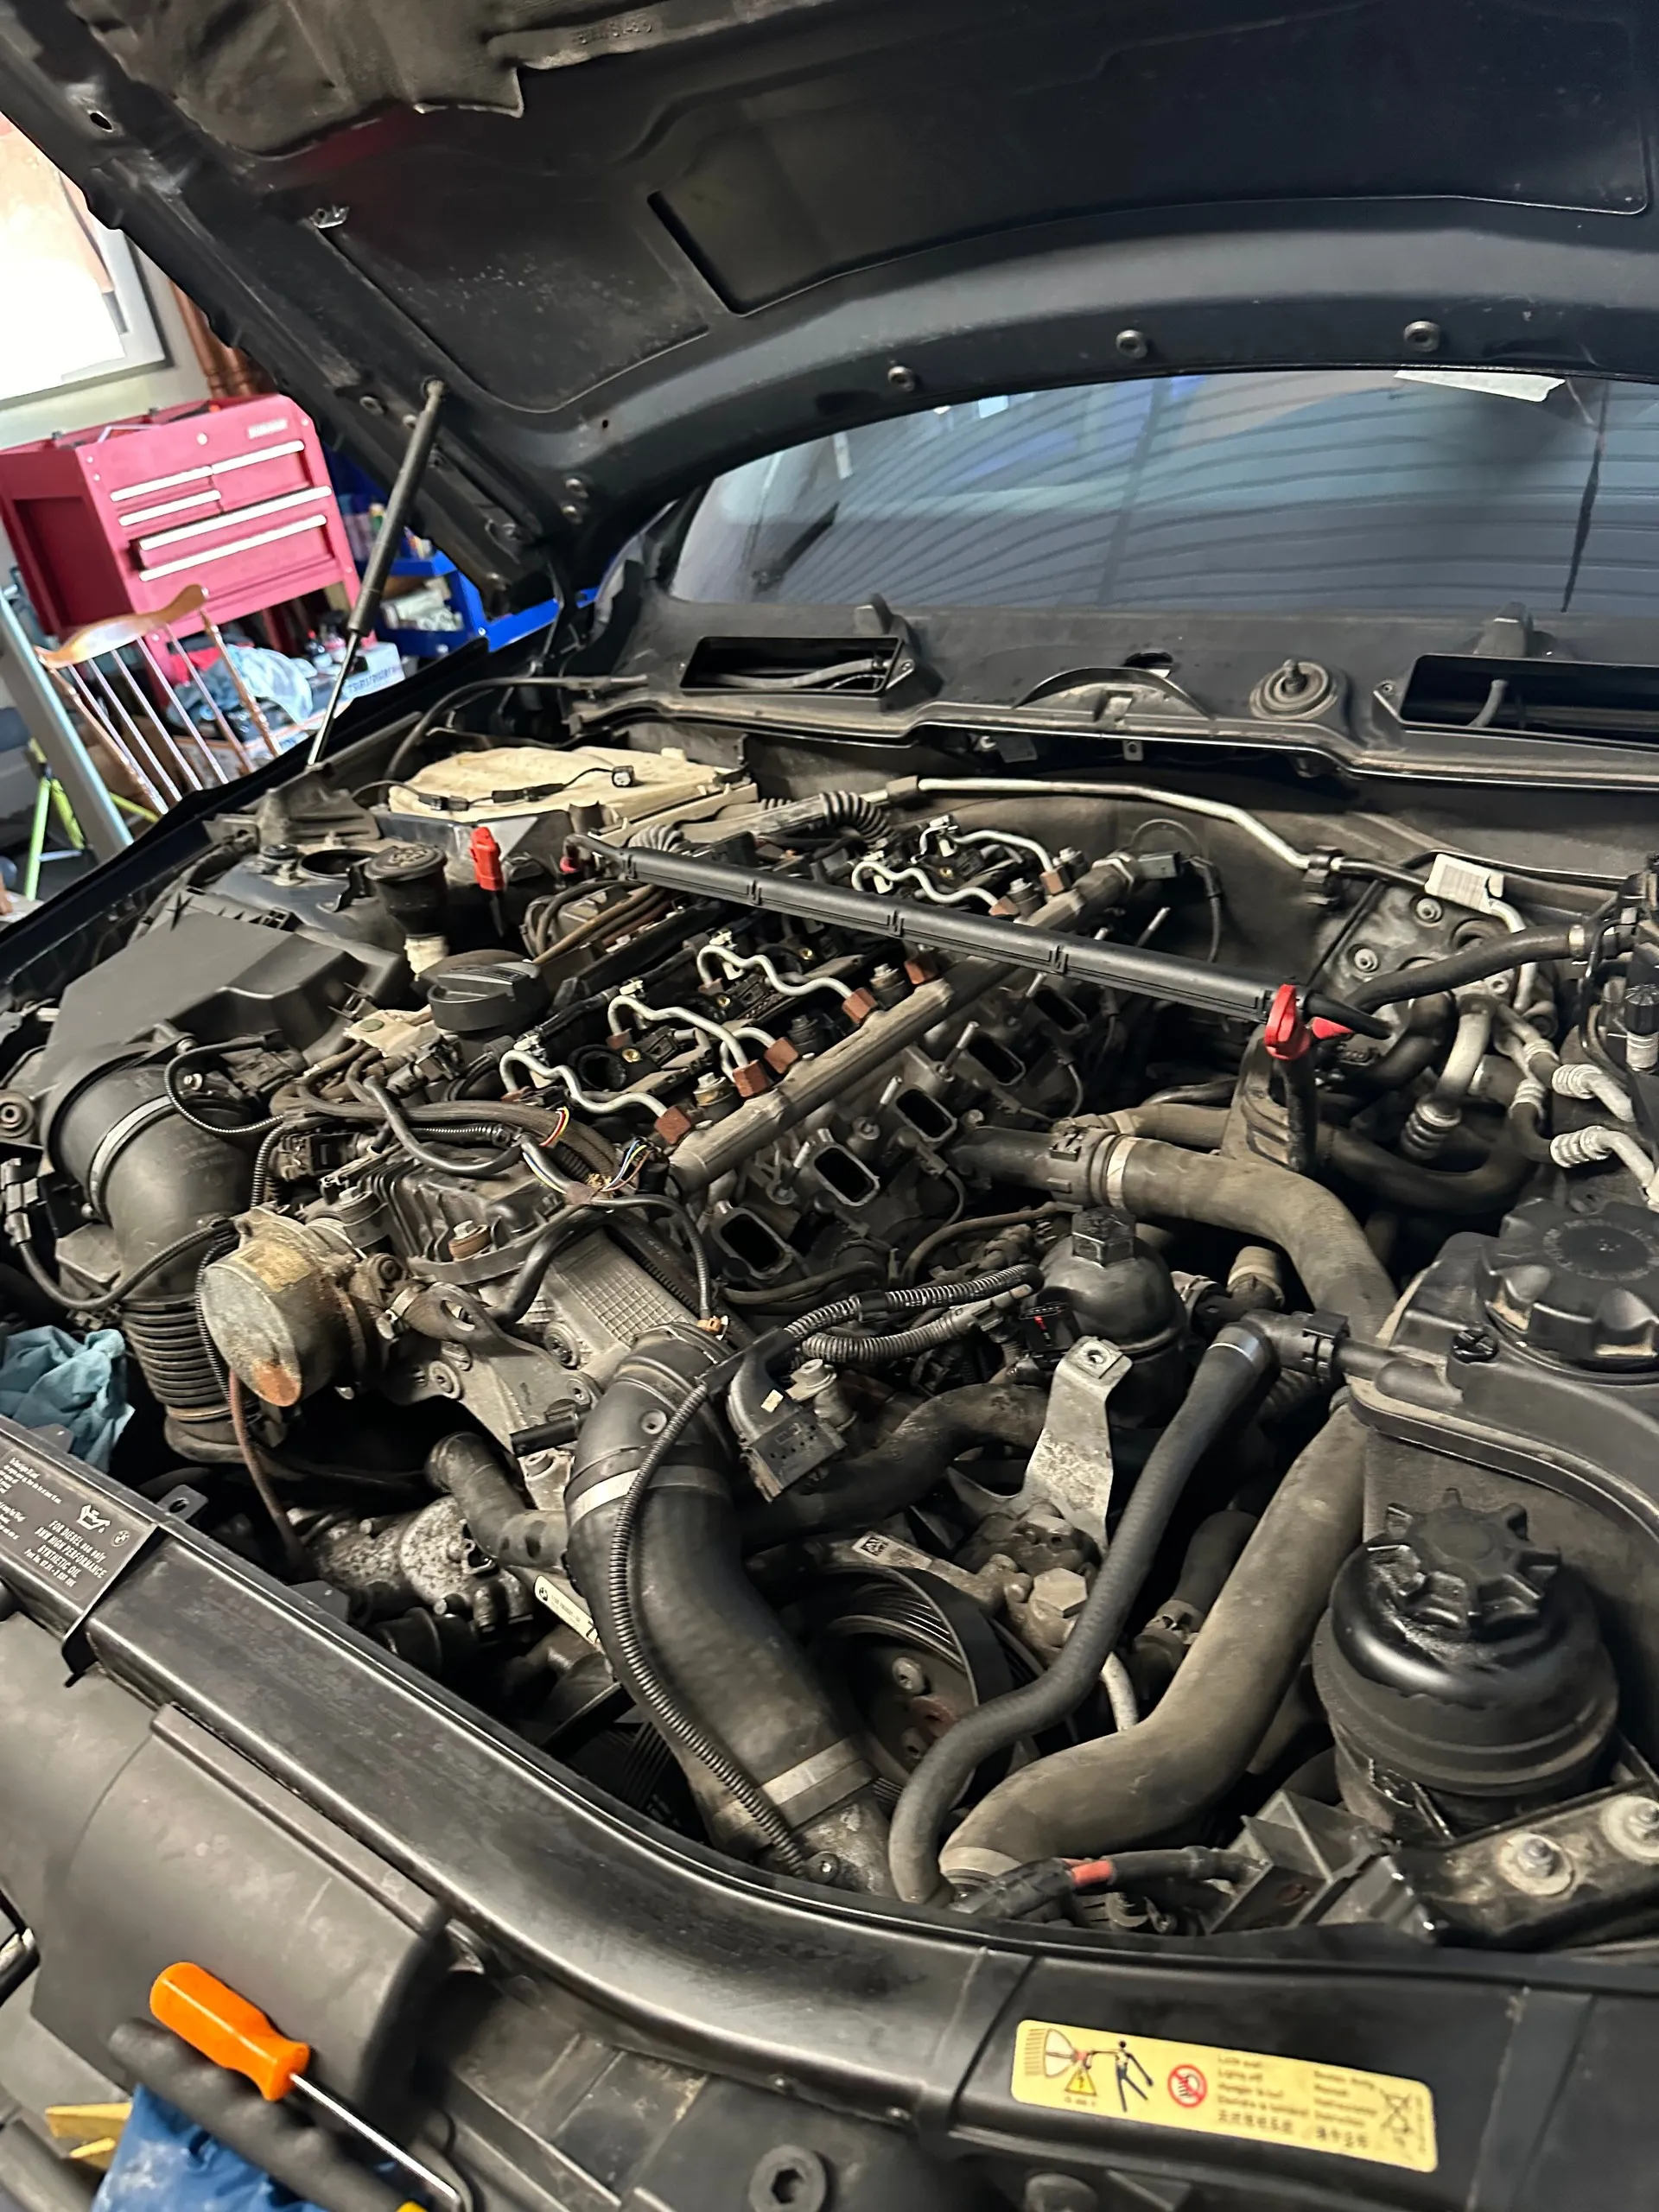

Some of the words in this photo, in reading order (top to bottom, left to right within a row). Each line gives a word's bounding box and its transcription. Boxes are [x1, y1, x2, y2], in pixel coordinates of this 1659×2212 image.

[48, 1520, 65, 1534] FOR
[60, 1528, 84, 1547] DIESEL
[37, 1544, 72, 1570] SYNTHETIC
[67, 1565, 82, 1578] OIL
[48, 1535, 67, 1550] HIGH
[61, 1545, 108, 1579] PERFORMANCE
